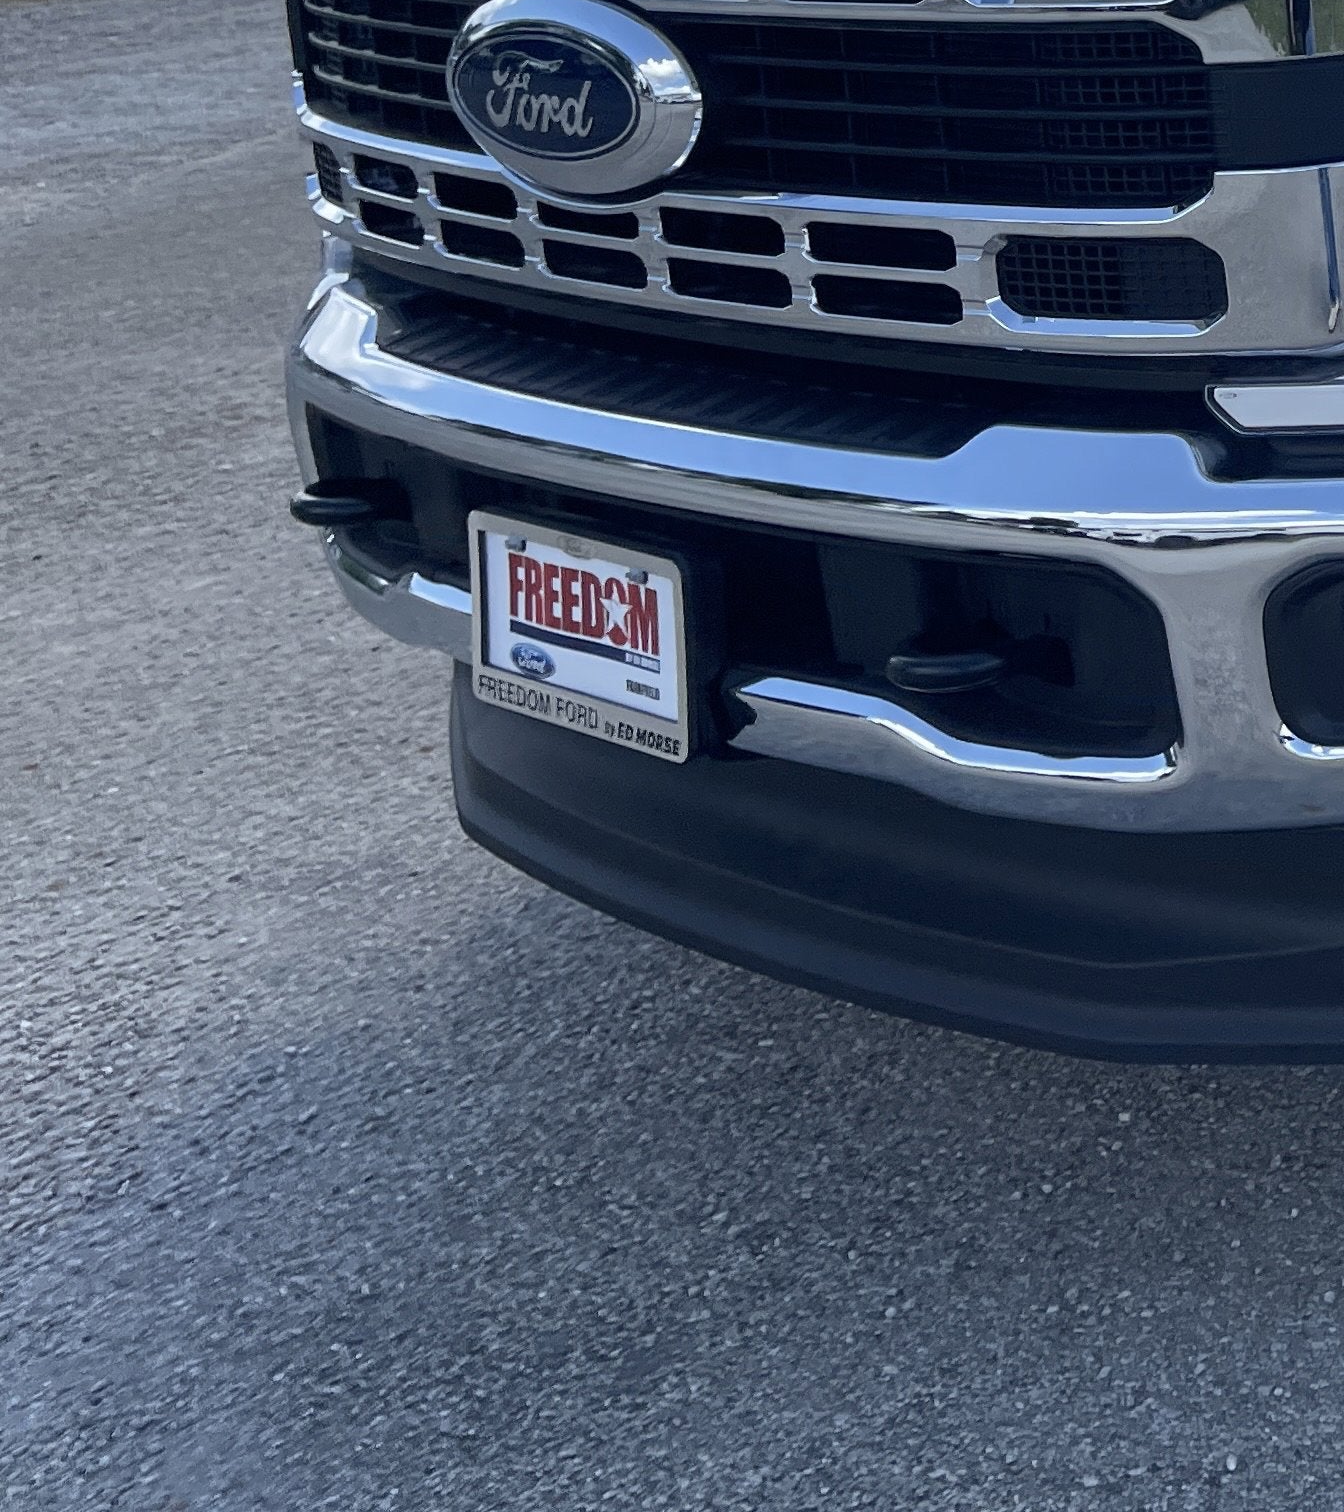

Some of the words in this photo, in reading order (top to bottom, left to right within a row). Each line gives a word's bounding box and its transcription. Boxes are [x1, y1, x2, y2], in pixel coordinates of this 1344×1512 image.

[486, 49, 594, 139] Ford
[508, 552, 661, 657] FREEDOM
[477, 674, 551, 715] FREEDOM
[555, 696, 599, 729] FORD
[617, 720, 634, 741] ED
[635, 728, 681, 757] MORSE
